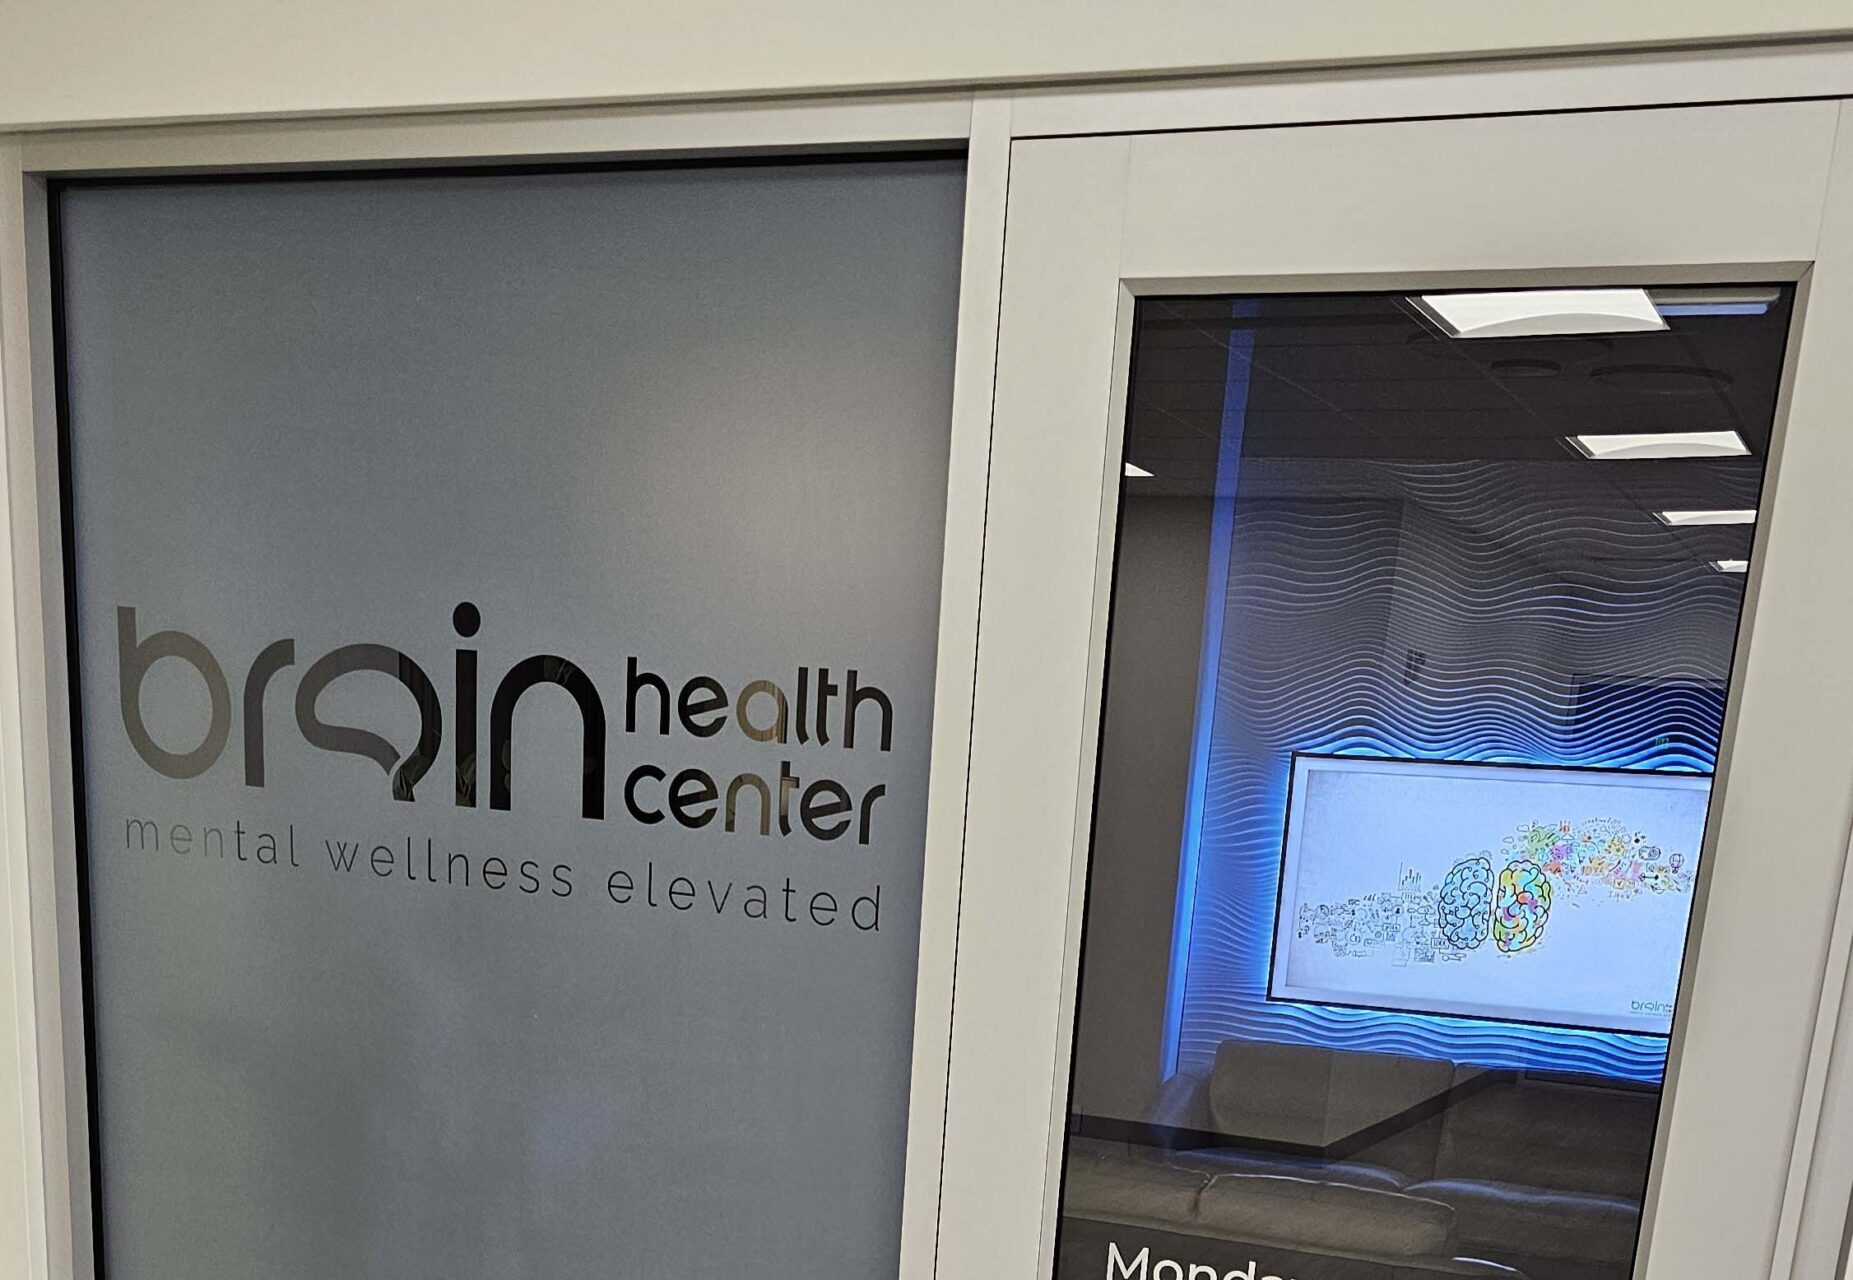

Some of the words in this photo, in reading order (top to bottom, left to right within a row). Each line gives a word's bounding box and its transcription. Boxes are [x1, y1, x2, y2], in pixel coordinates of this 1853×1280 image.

[116, 601, 606, 821] brain
[625, 656, 894, 752] health
[624, 761, 886, 845] center
[124, 813, 300, 868] mental
[325, 835, 575, 898] wellness
[607, 863, 883, 933] elevated
